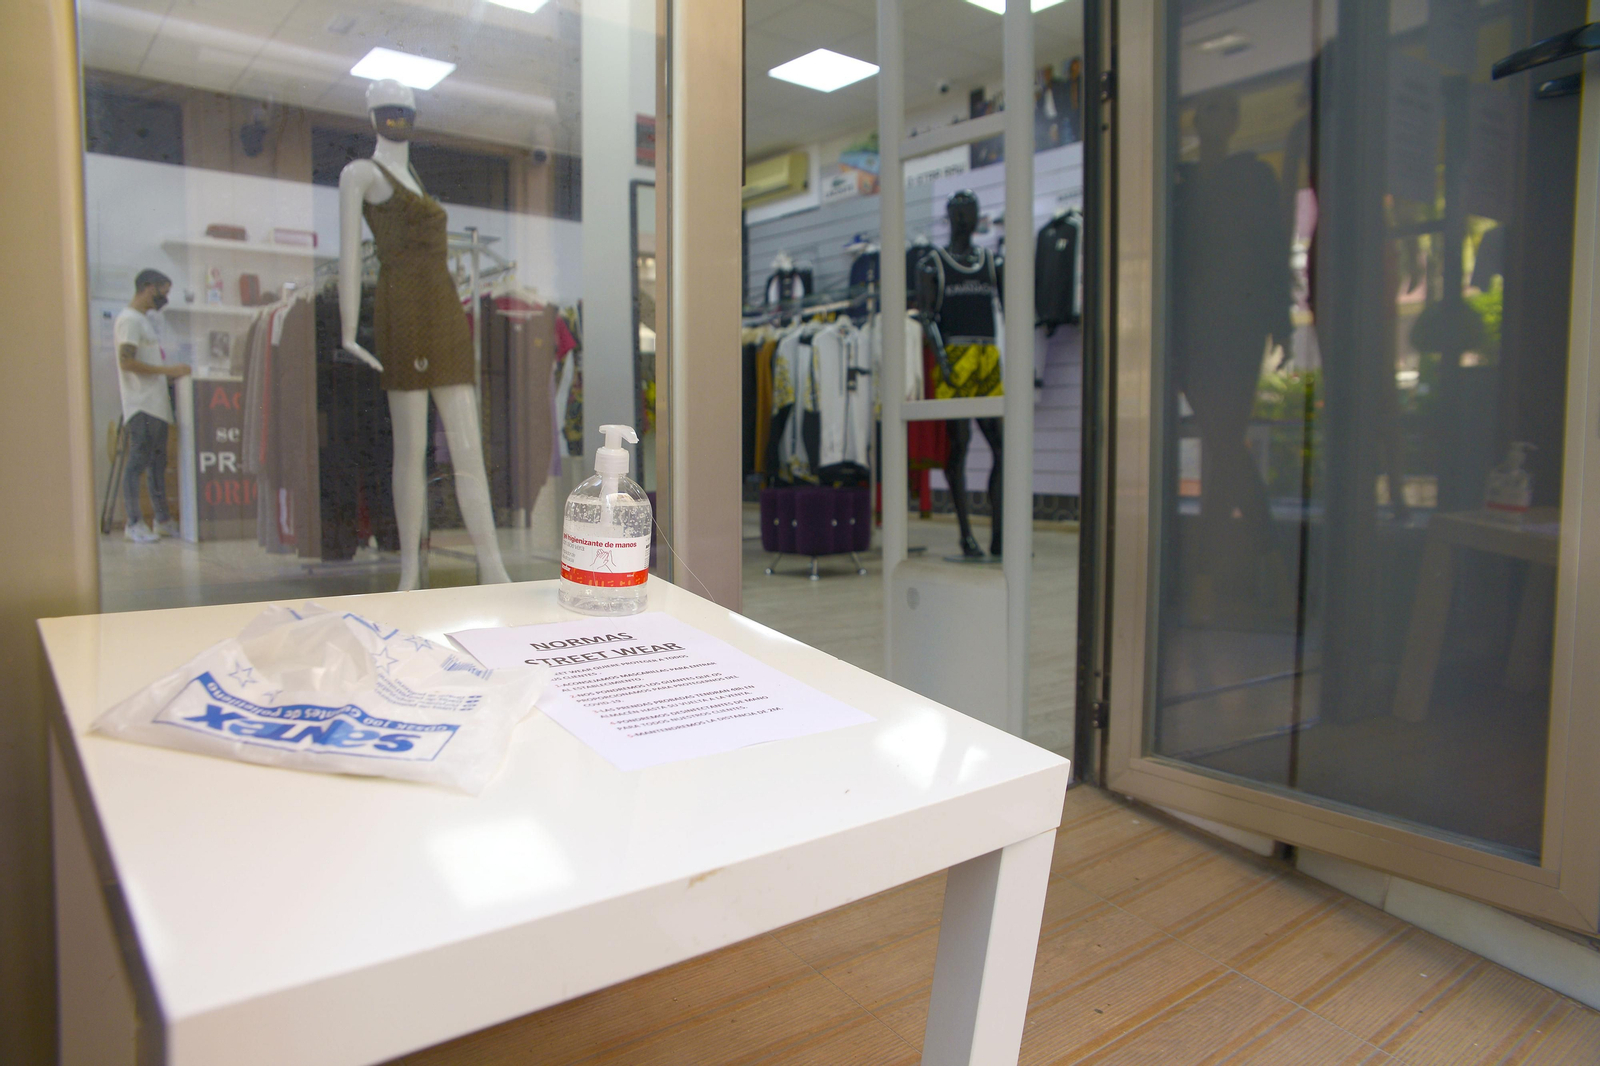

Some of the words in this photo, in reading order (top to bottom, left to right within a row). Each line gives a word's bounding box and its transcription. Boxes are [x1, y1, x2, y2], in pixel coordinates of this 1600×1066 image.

[200, 451, 241, 473] PR
[567, 534, 603, 548] higienizante
[530, 632, 634, 650] NORMAS
[524, 650, 610, 666] STREET
[611, 642, 683, 656] WEAR
